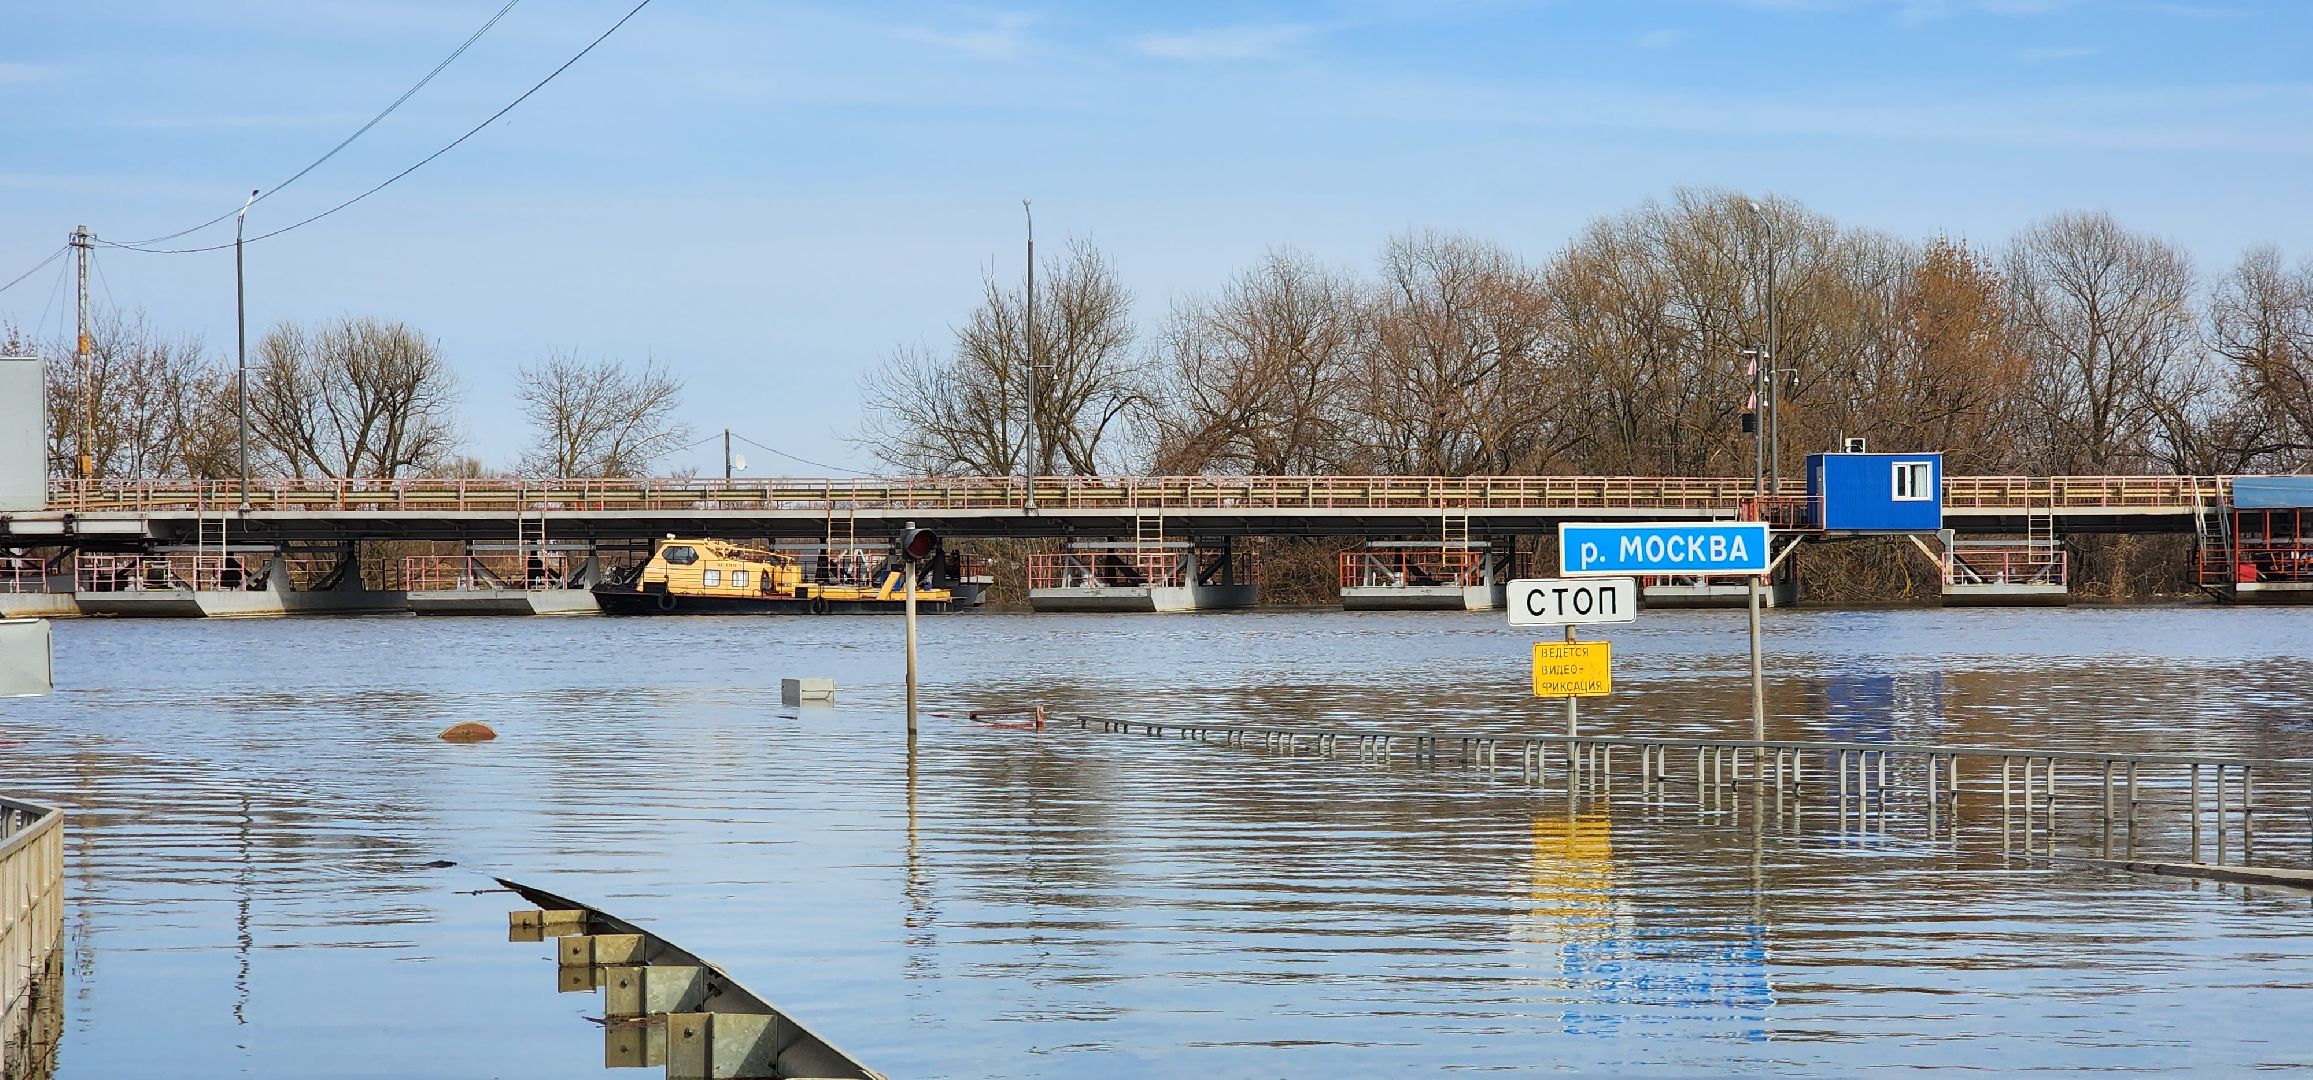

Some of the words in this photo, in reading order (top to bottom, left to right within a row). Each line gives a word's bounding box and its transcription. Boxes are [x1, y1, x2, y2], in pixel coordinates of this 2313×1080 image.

[1581, 541, 1606, 571] р.
[1619, 534, 1749, 563] МОСКВА
[1526, 586, 1617, 617] СТОП
[1541, 664, 1584, 675] ВИДЕО-
[1542, 681, 1603, 693] ФИКСАЦИЯ
